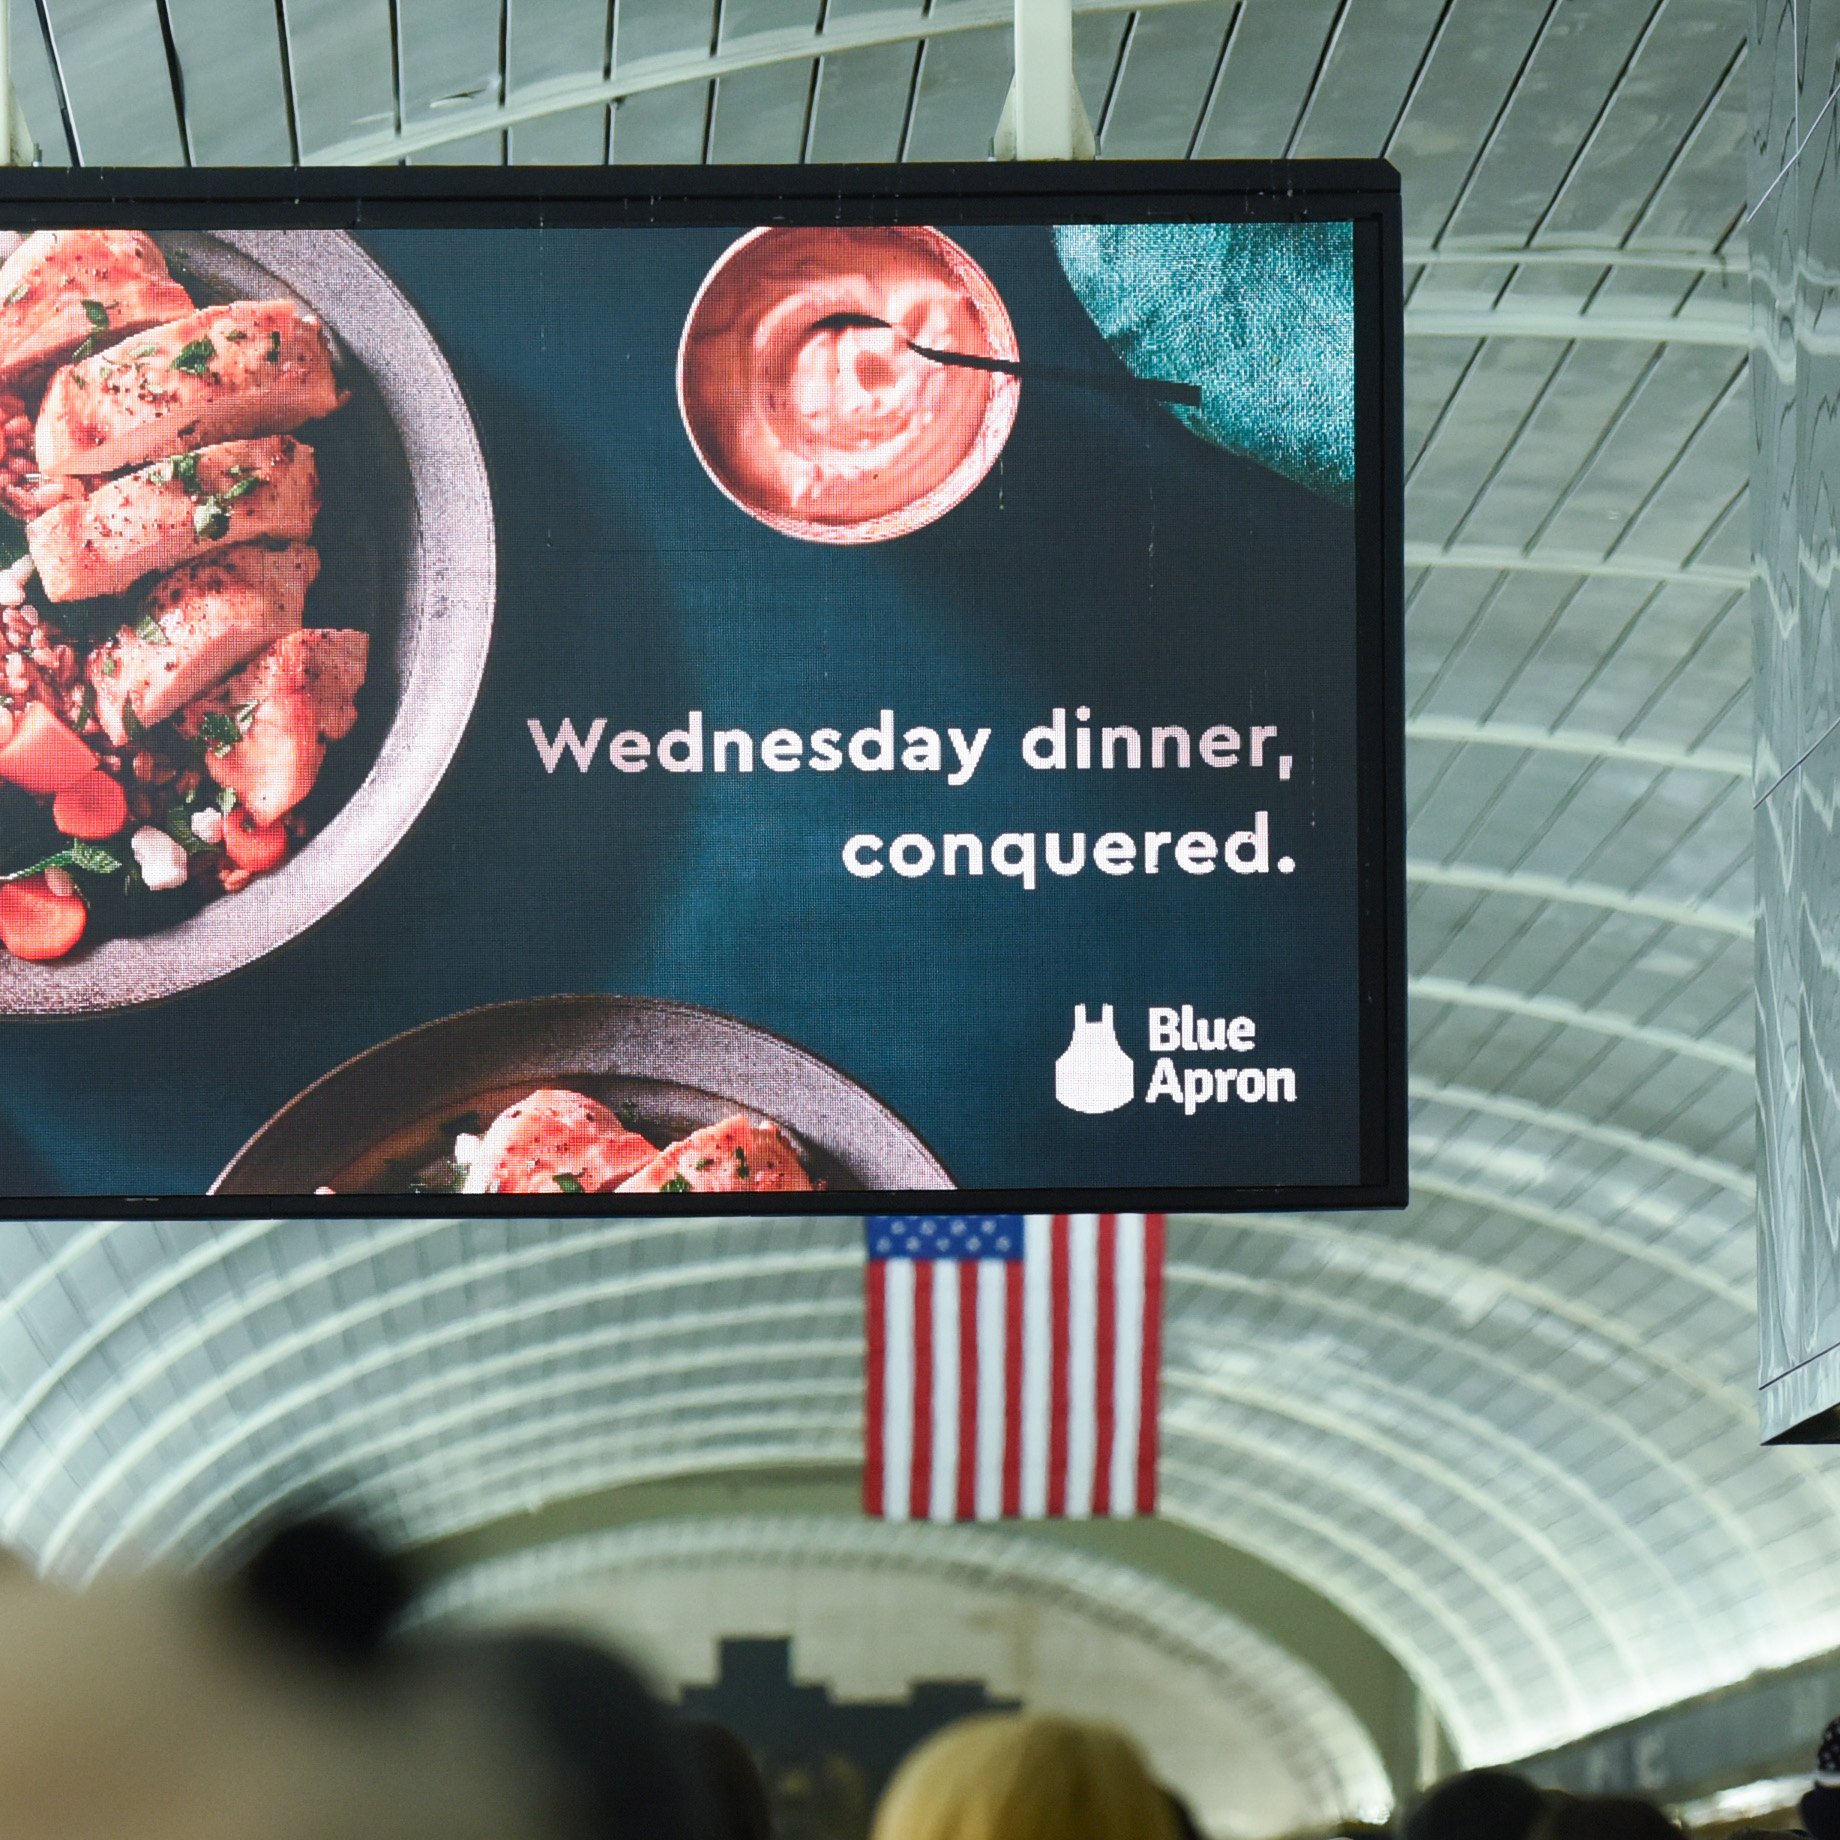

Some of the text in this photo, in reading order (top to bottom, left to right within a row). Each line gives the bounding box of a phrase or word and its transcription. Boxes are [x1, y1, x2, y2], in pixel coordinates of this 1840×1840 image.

[527, 706, 1293, 785] Wednesday dinner,
[841, 811, 1297, 890] conquered.
[1146, 1006, 1257, 1052] Blue
[1144, 1057, 1298, 1116] Apron
